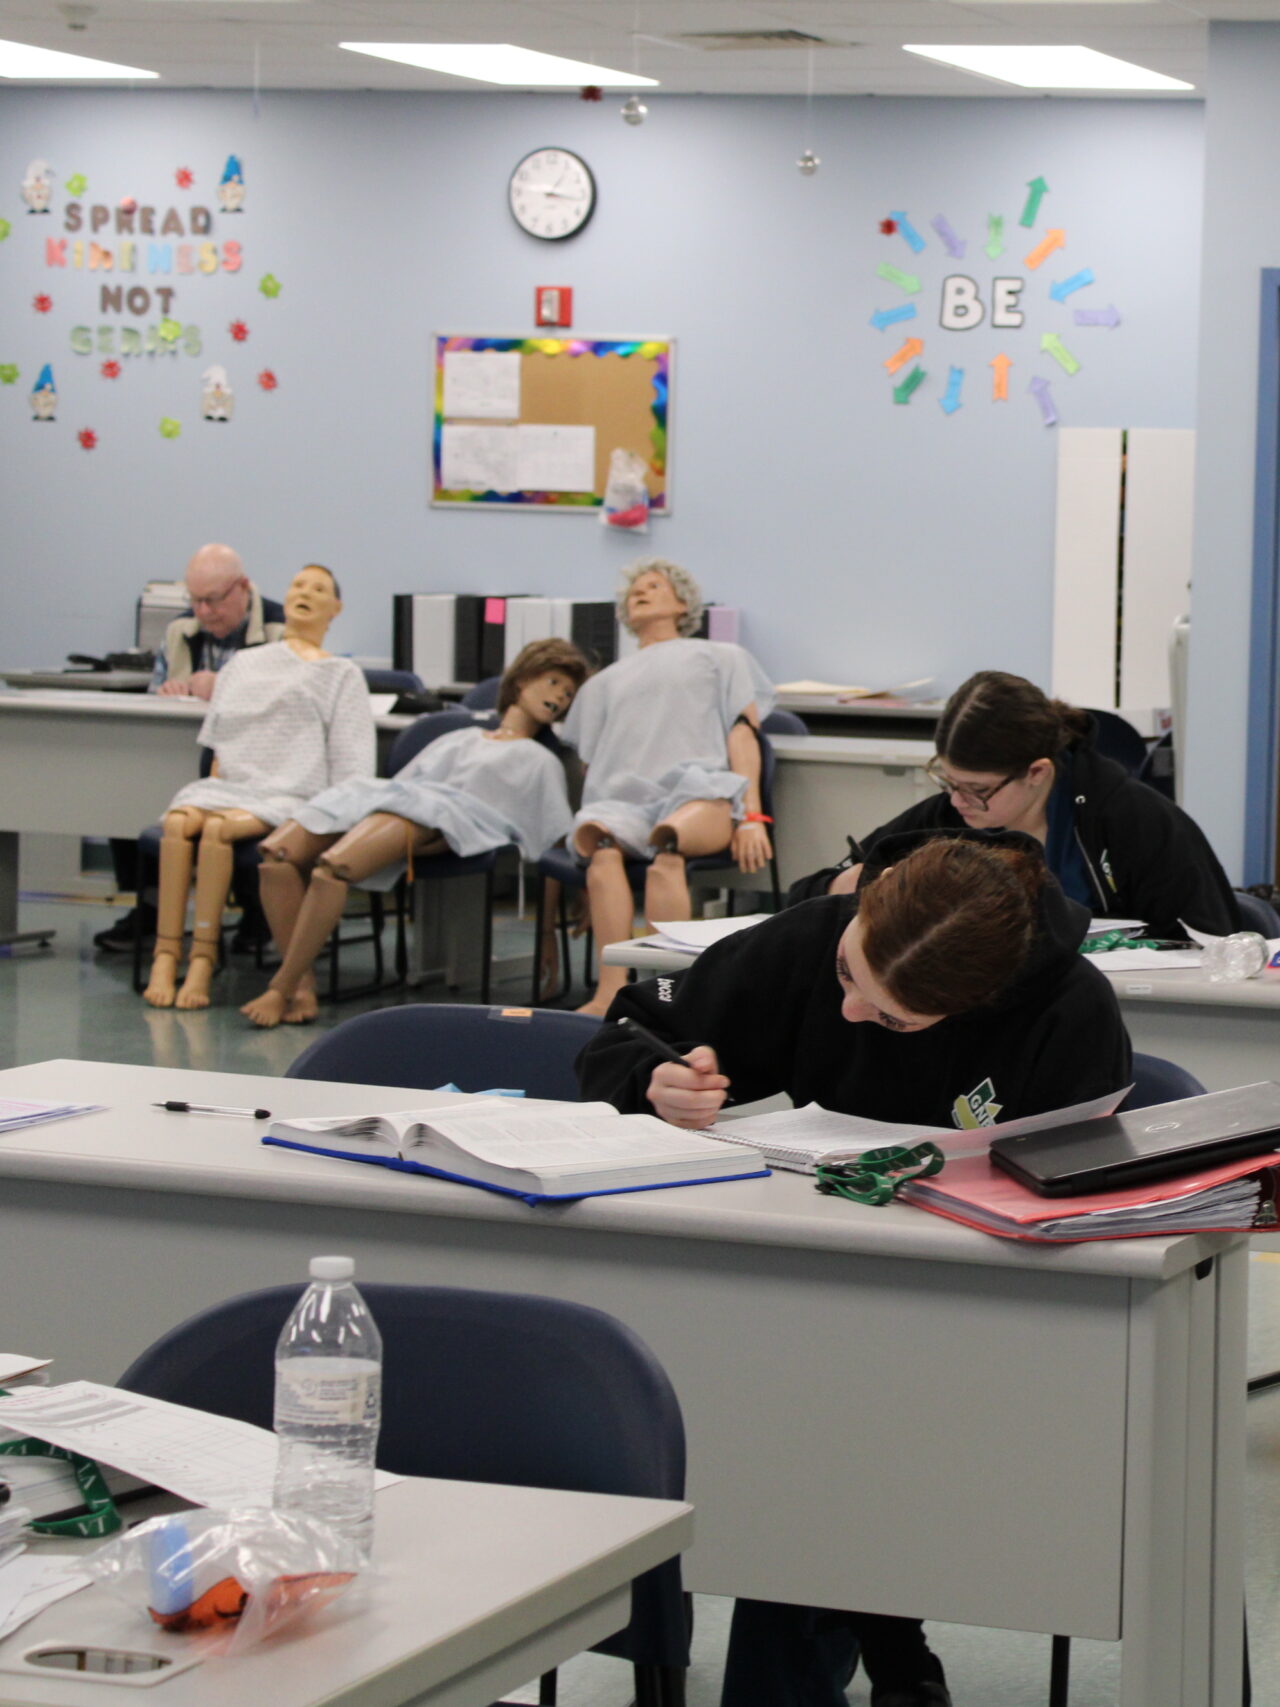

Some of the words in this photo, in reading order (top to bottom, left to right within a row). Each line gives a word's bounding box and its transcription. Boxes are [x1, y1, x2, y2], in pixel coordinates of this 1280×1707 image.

[64, 202, 212, 237] SPREAD
[101, 284, 175, 316] NOT
[938, 273, 1026, 331] BE
